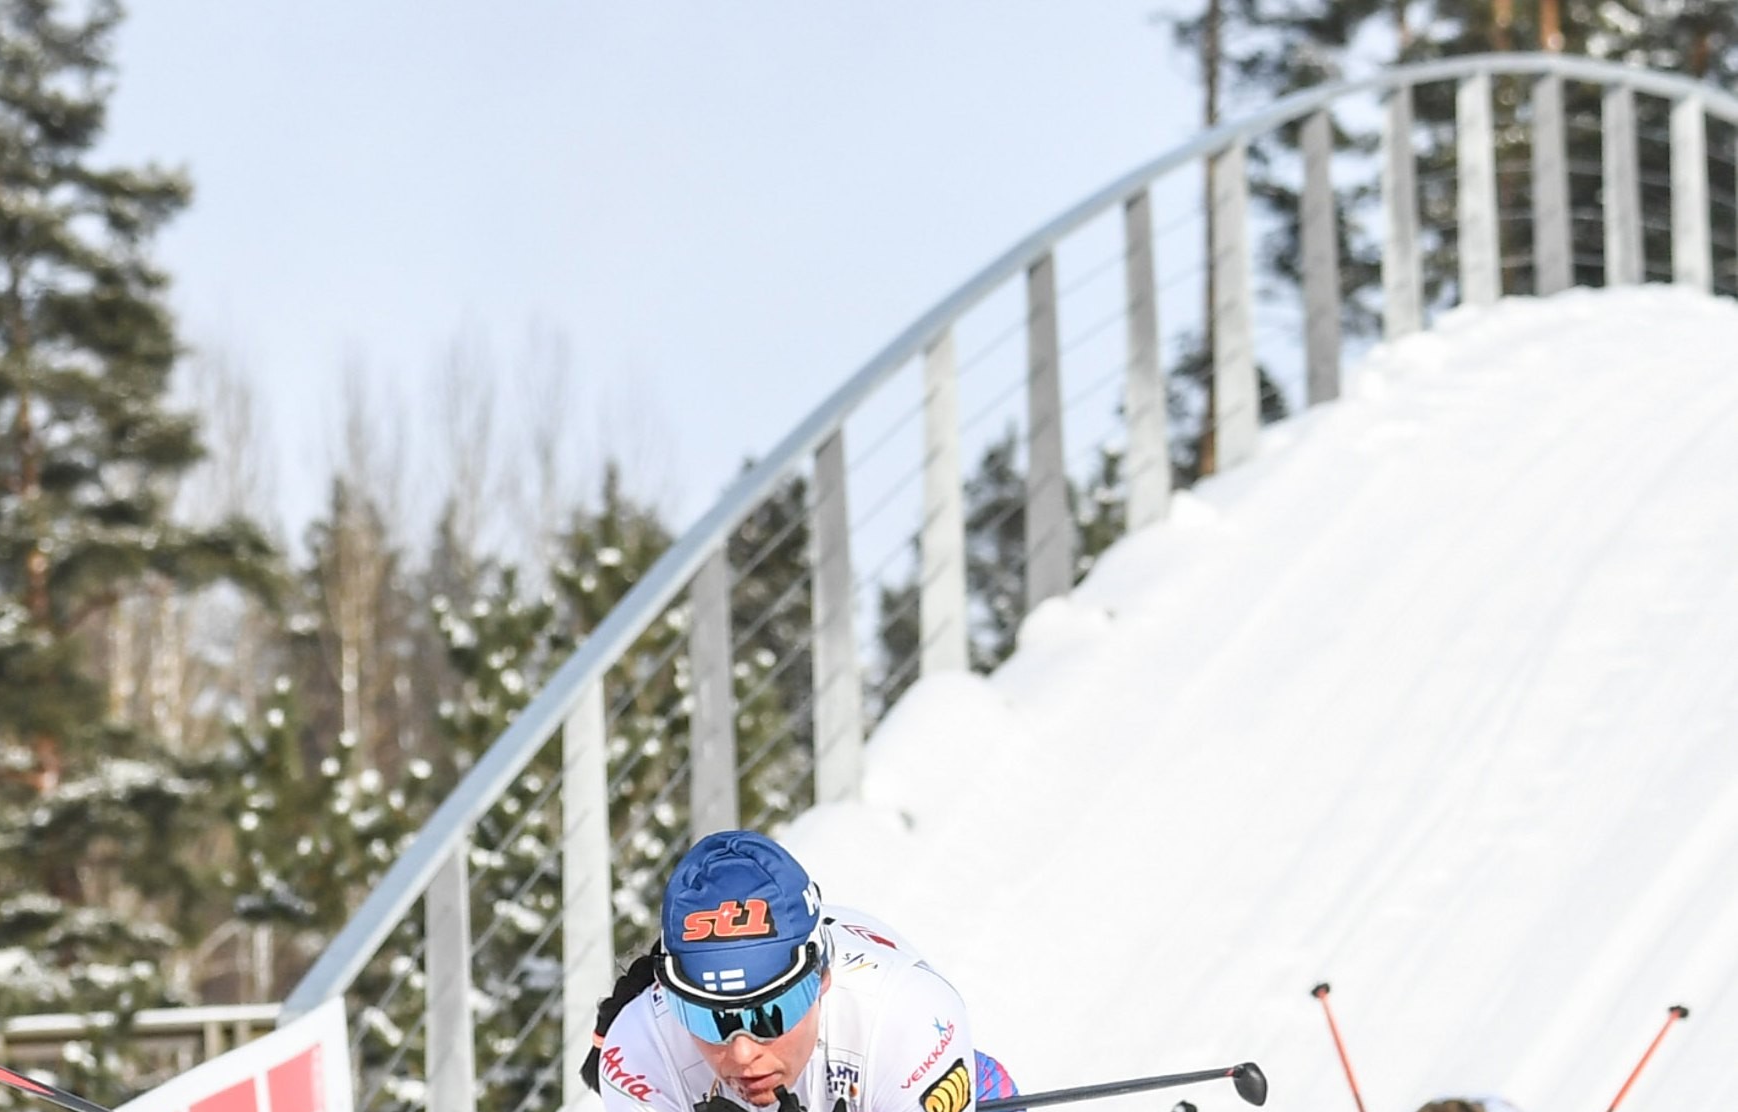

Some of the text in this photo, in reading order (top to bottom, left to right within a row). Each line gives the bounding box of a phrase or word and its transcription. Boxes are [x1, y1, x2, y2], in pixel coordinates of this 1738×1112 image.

[682, 898, 770, 942] st1
[602, 1046, 654, 1103] Atria
[900, 1020, 955, 1090] VEIKKAUS
